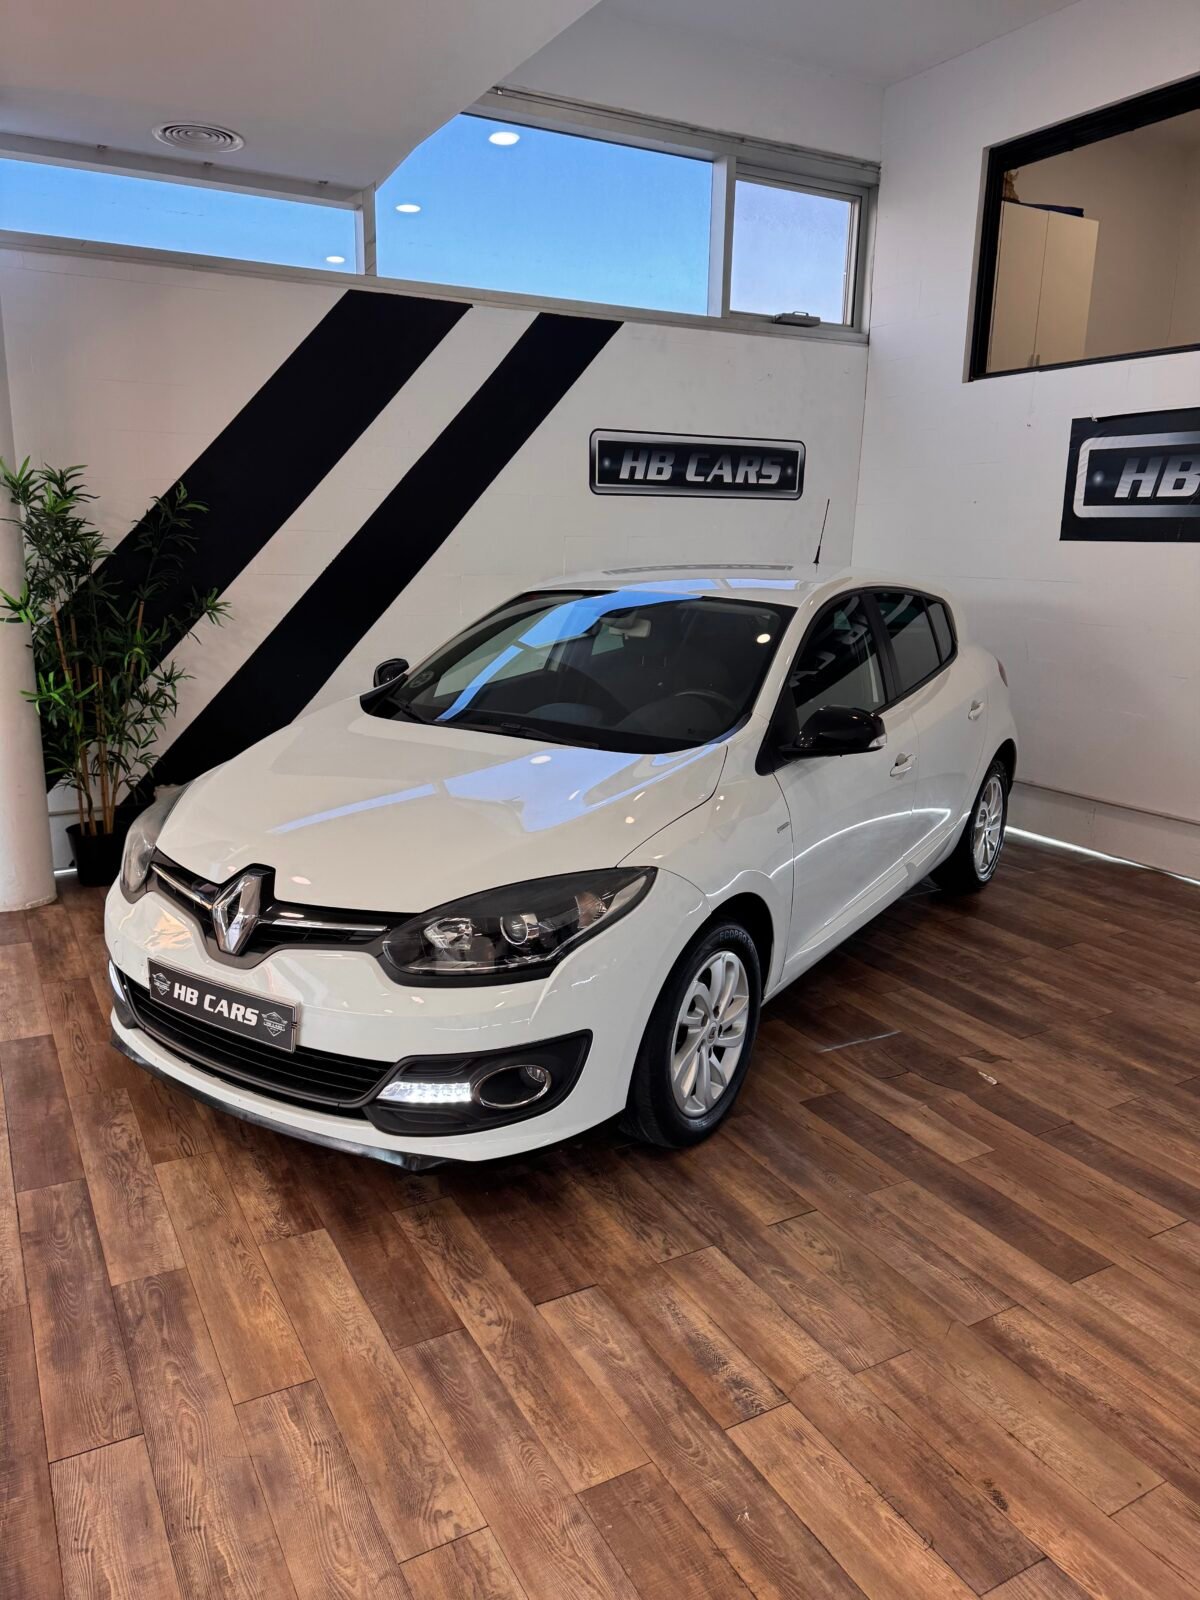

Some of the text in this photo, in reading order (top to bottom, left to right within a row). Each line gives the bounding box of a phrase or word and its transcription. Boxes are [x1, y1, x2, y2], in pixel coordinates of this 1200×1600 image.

[619, 448, 784, 484] HB CARS
[1114, 455, 1200, 498] HB
[173, 982, 259, 1026] HB CARS
